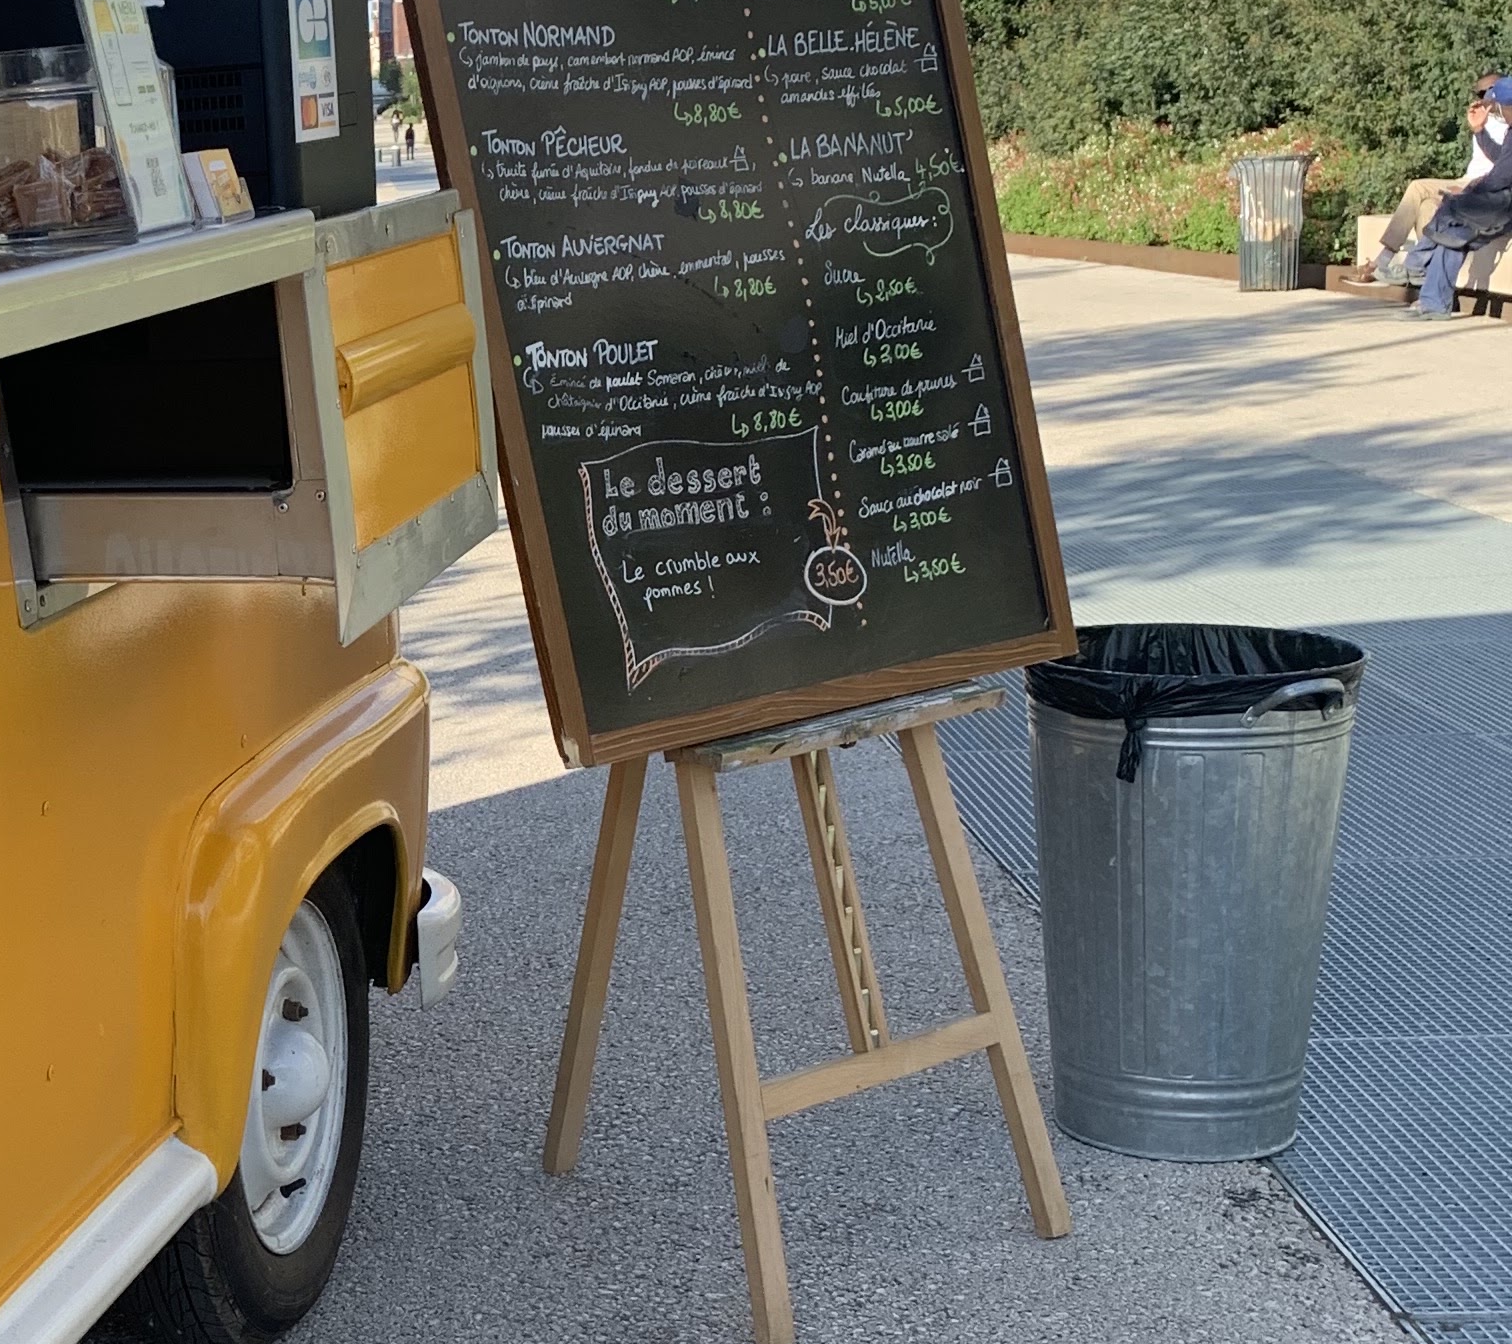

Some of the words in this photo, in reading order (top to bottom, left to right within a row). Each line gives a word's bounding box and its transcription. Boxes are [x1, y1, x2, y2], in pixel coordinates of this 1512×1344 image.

[458, 21, 518, 46] TONTON
[523, 21, 615, 48] NORMAND
[768, 34, 788, 56] LA
[482, 129, 536, 157] TONTON
[541, 125, 628, 158] PÊCHEUR
[790, 136, 811, 160] LA
[862, 163, 911, 184] Nutella
[805, 207, 836, 242] Les
[500, 236, 555, 259] TONTON
[562, 234, 665, 258] AUVERGNAT
[834, 325, 859, 349] Miel
[525, 341, 588, 370] TONTON
[593, 339, 659, 366] POULET
[603, 468, 636, 499] Le
[647, 453, 762, 496] dessert
[602, 505, 633, 536] du
[638, 492, 750, 531] moment
[622, 559, 645, 584] Le
[655, 549, 721, 576] crumble
[726, 550, 761, 565] aux
[871, 539, 916, 568] Nutella
[643, 580, 702, 612] pommes
